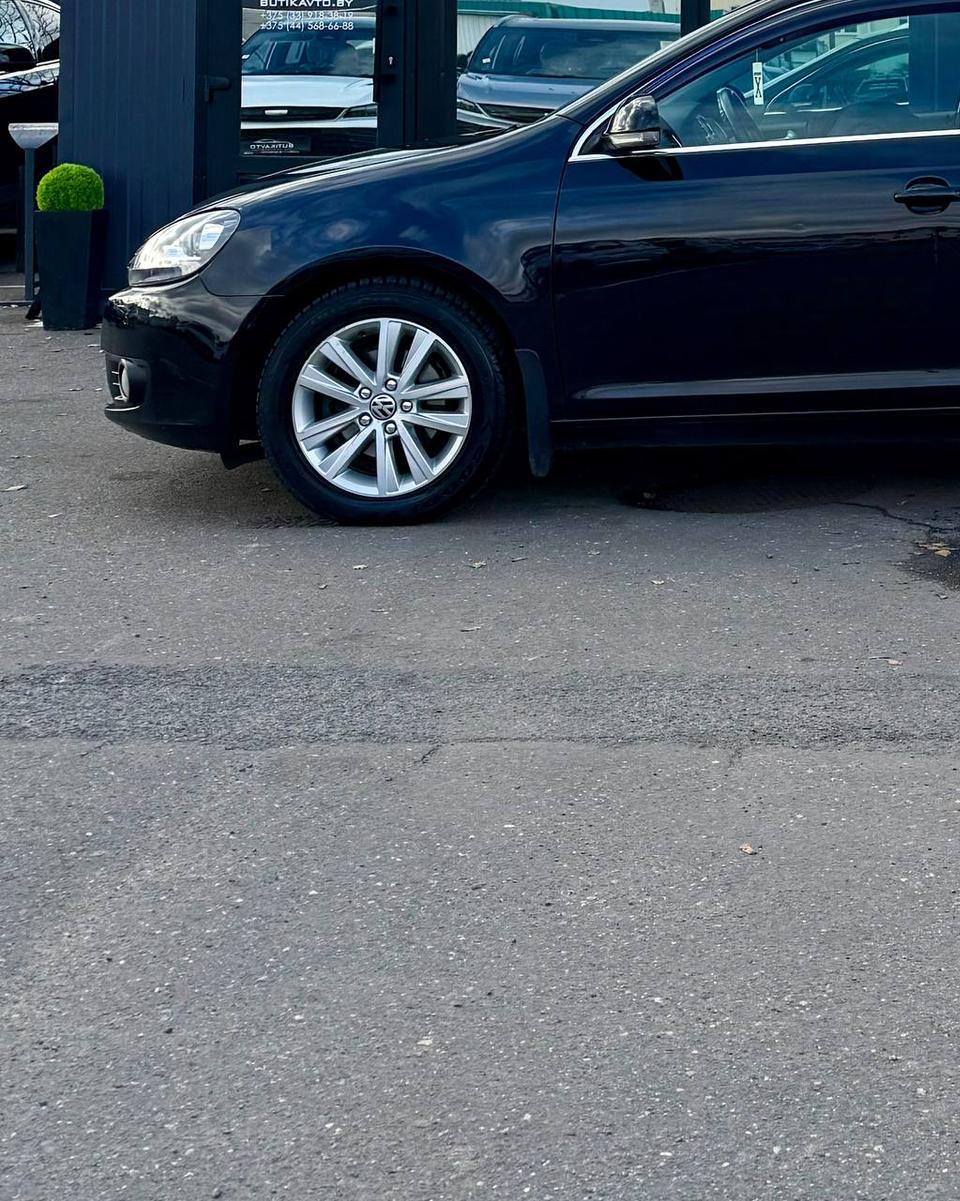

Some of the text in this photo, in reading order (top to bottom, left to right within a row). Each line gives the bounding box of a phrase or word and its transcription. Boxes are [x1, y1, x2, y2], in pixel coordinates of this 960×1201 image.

[260, 20, 354, 32] +375 (44) 568-66-88
